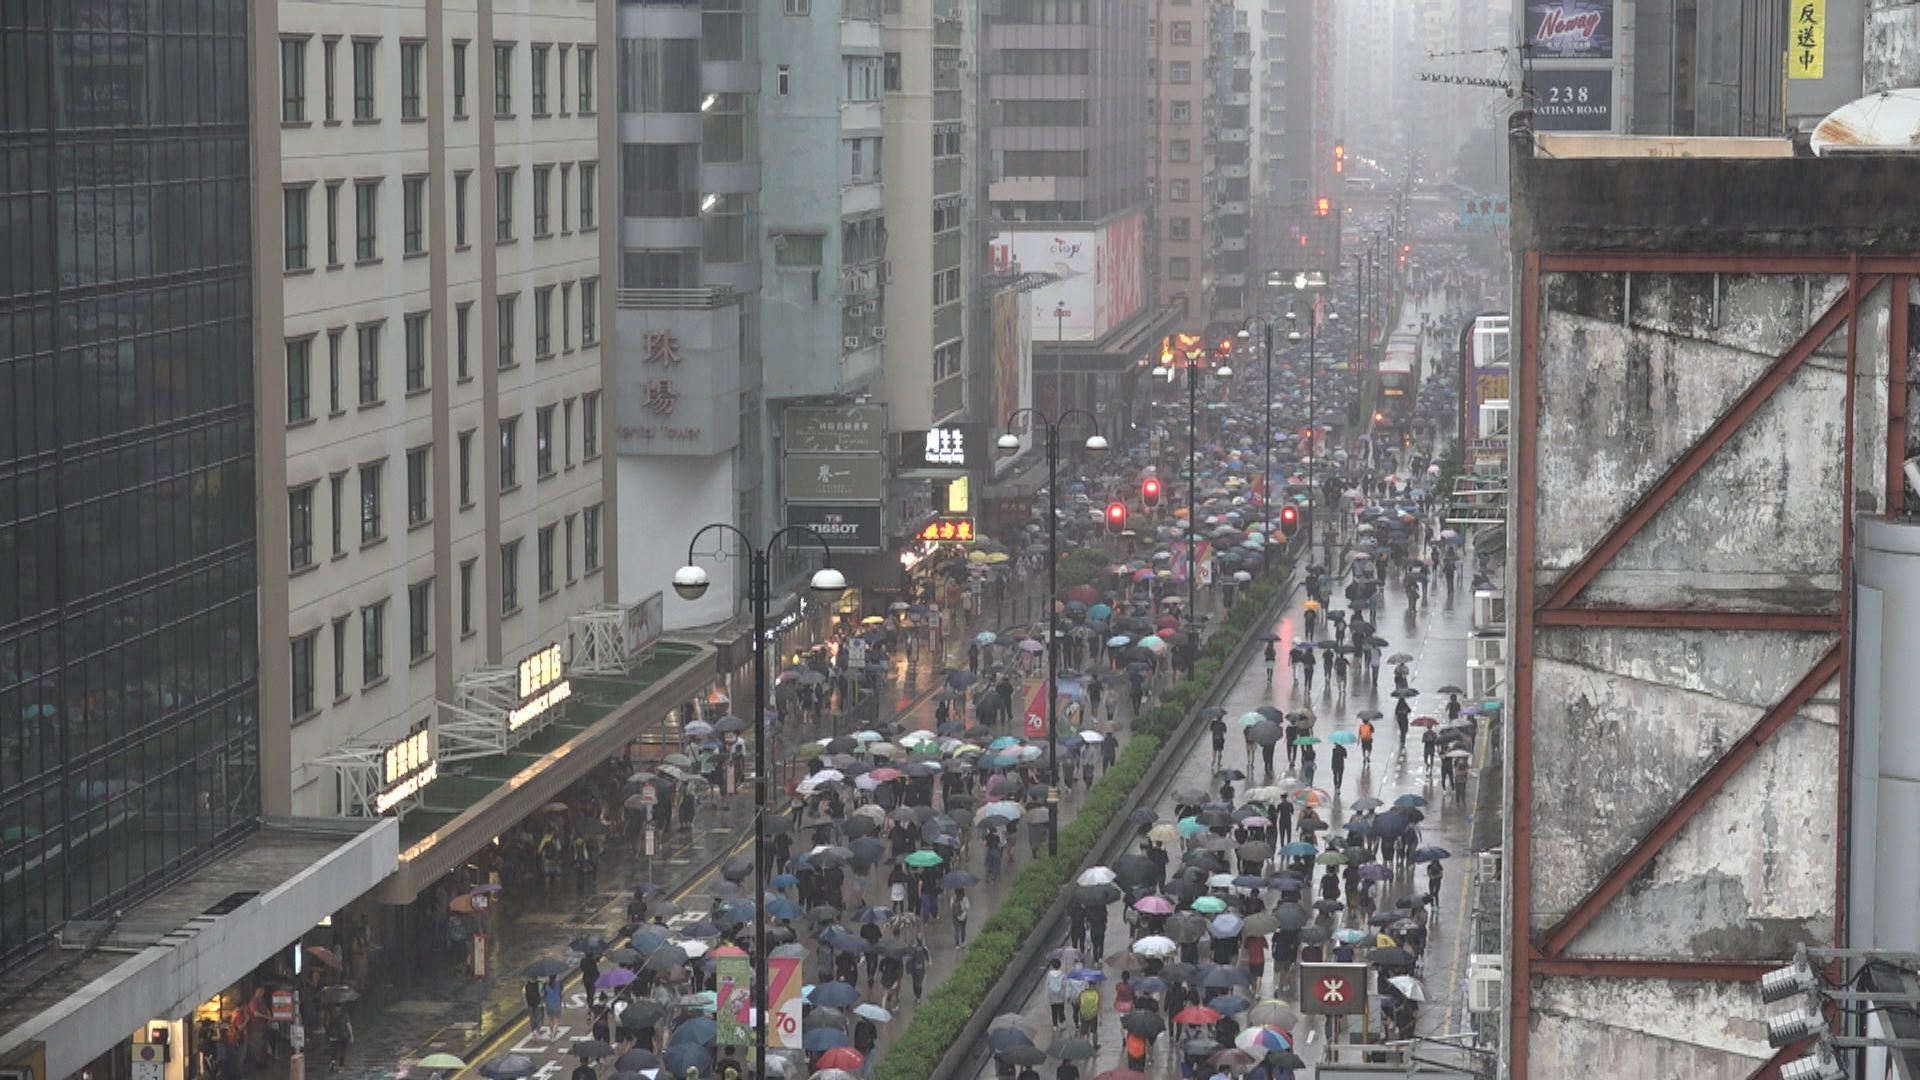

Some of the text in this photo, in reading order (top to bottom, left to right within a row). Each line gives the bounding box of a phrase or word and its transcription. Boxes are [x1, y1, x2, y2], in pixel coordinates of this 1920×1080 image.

[1537, 7, 1601, 40] Neway
[1797, 3, 1818, 71] 反送中
[1549, 86, 1589, 103] 238
[1576, 105, 1607, 115] ROAD
[808, 524, 859, 533] TISSOT
[1028, 713, 1043, 729] 70
[775, 1012, 796, 1033] 70
